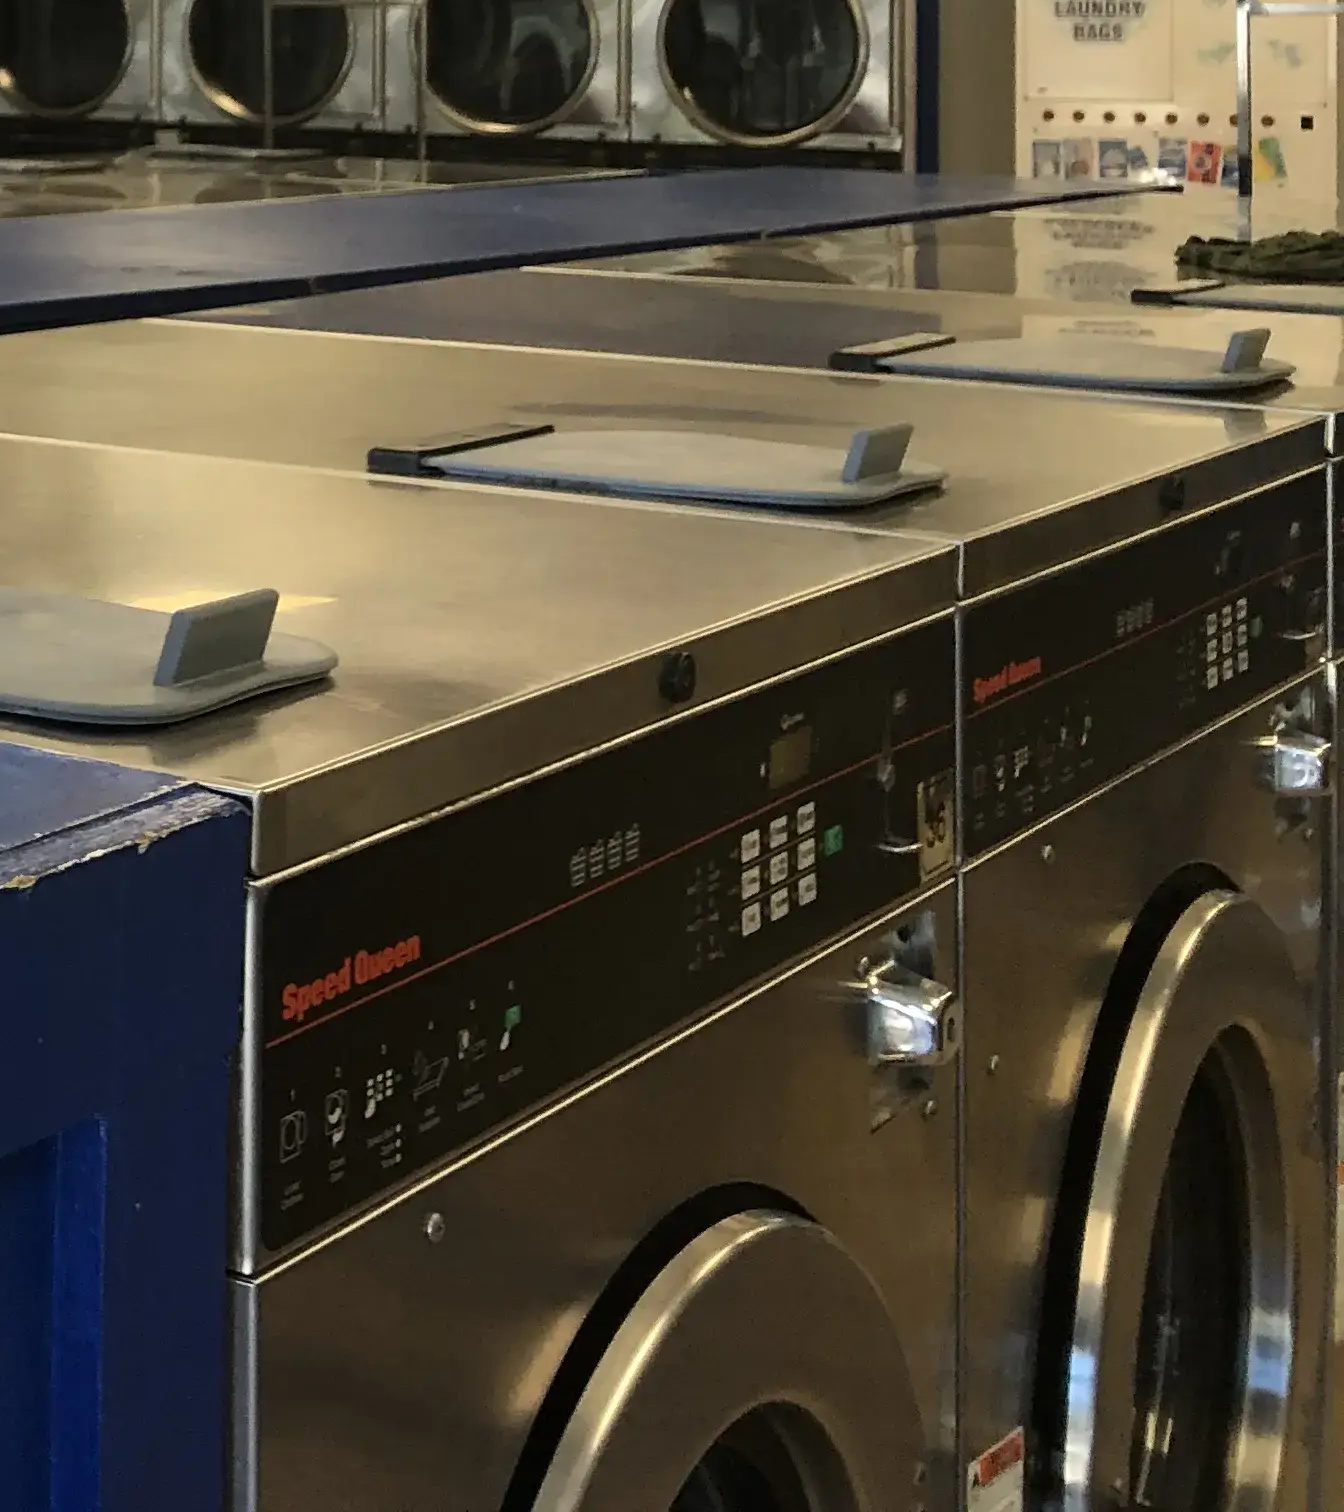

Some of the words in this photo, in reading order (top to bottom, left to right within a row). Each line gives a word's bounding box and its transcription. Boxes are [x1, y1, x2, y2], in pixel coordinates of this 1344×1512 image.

[1054, 0, 1145, 18] LAUNDRY
[1073, 22, 1123, 42] BAGS
[282, 957, 352, 1021] Speed
[355, 936, 421, 985] Queen
